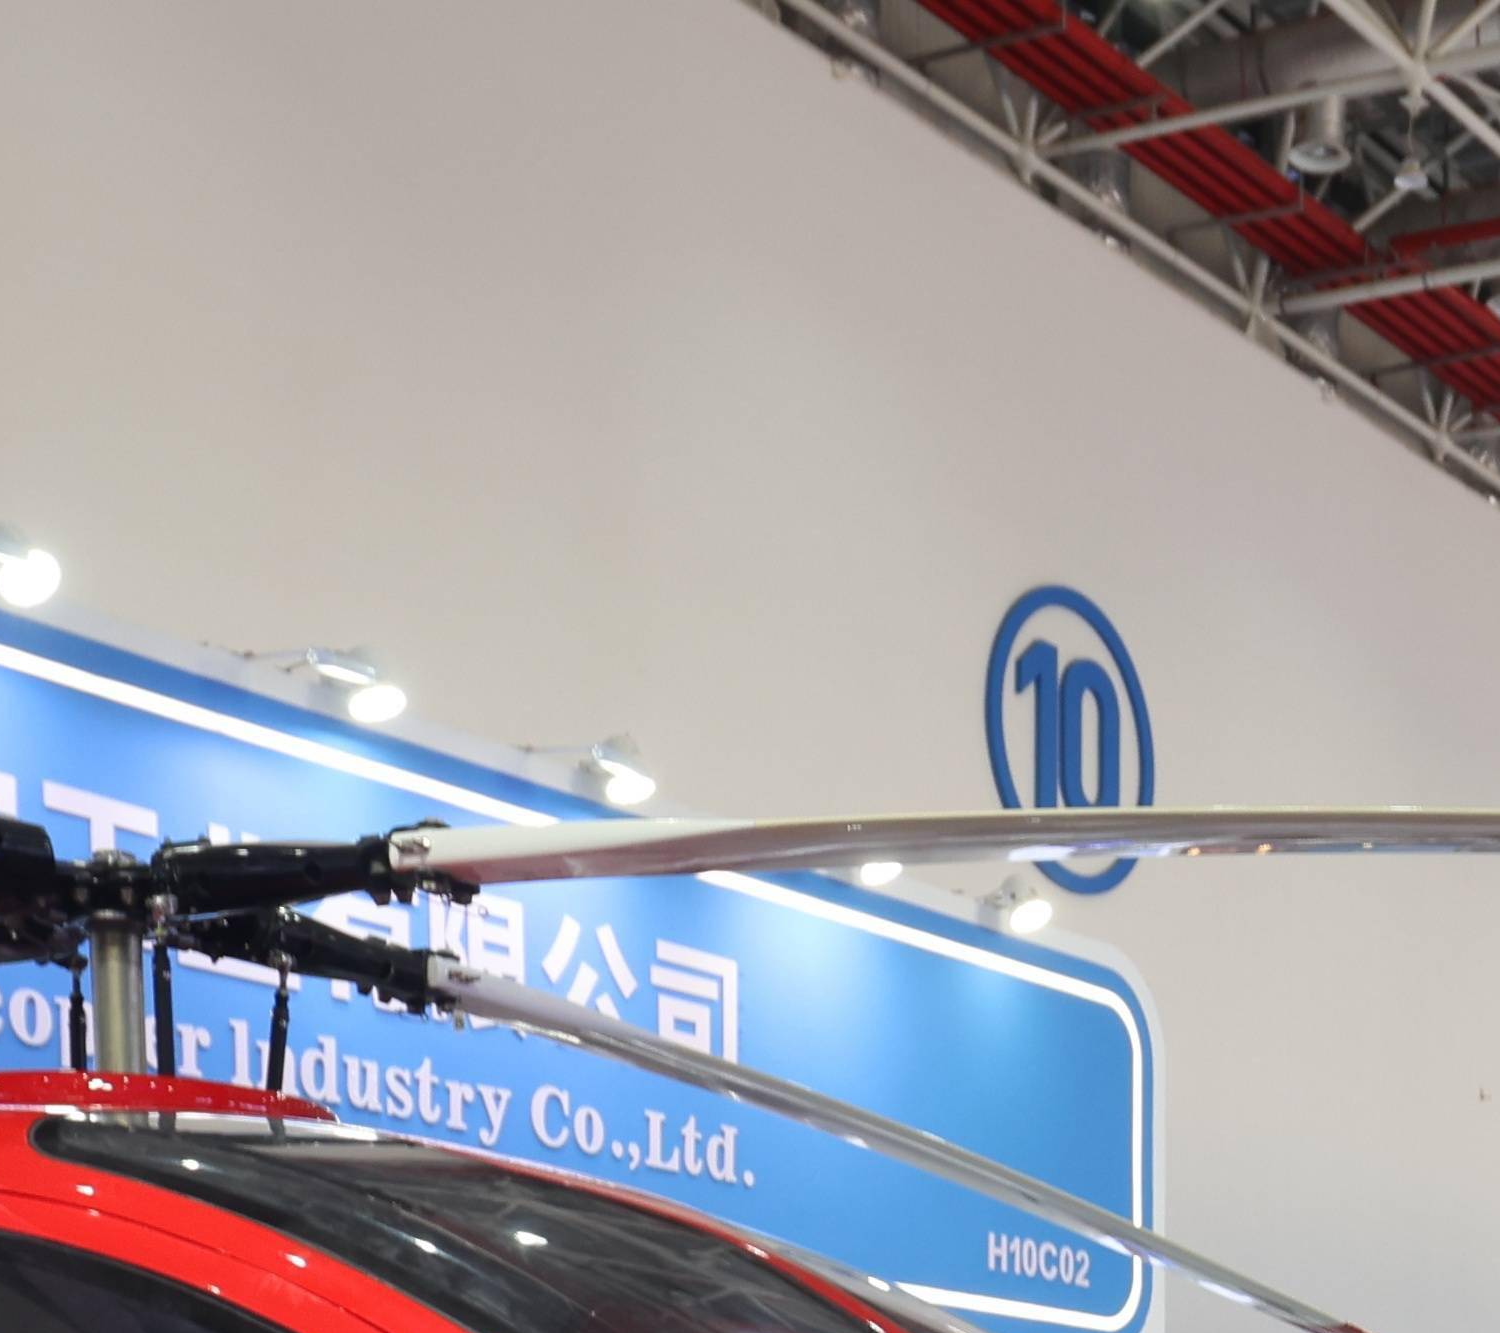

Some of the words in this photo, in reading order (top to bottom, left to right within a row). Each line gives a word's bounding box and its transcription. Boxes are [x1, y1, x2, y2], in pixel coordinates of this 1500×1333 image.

[1014, 637, 1121, 809] 10
[228, 1017, 512, 1147] Industry
[530, 1083, 755, 1187] Co.,Ltd.
[987, 1231, 1091, 1289] H10C02
